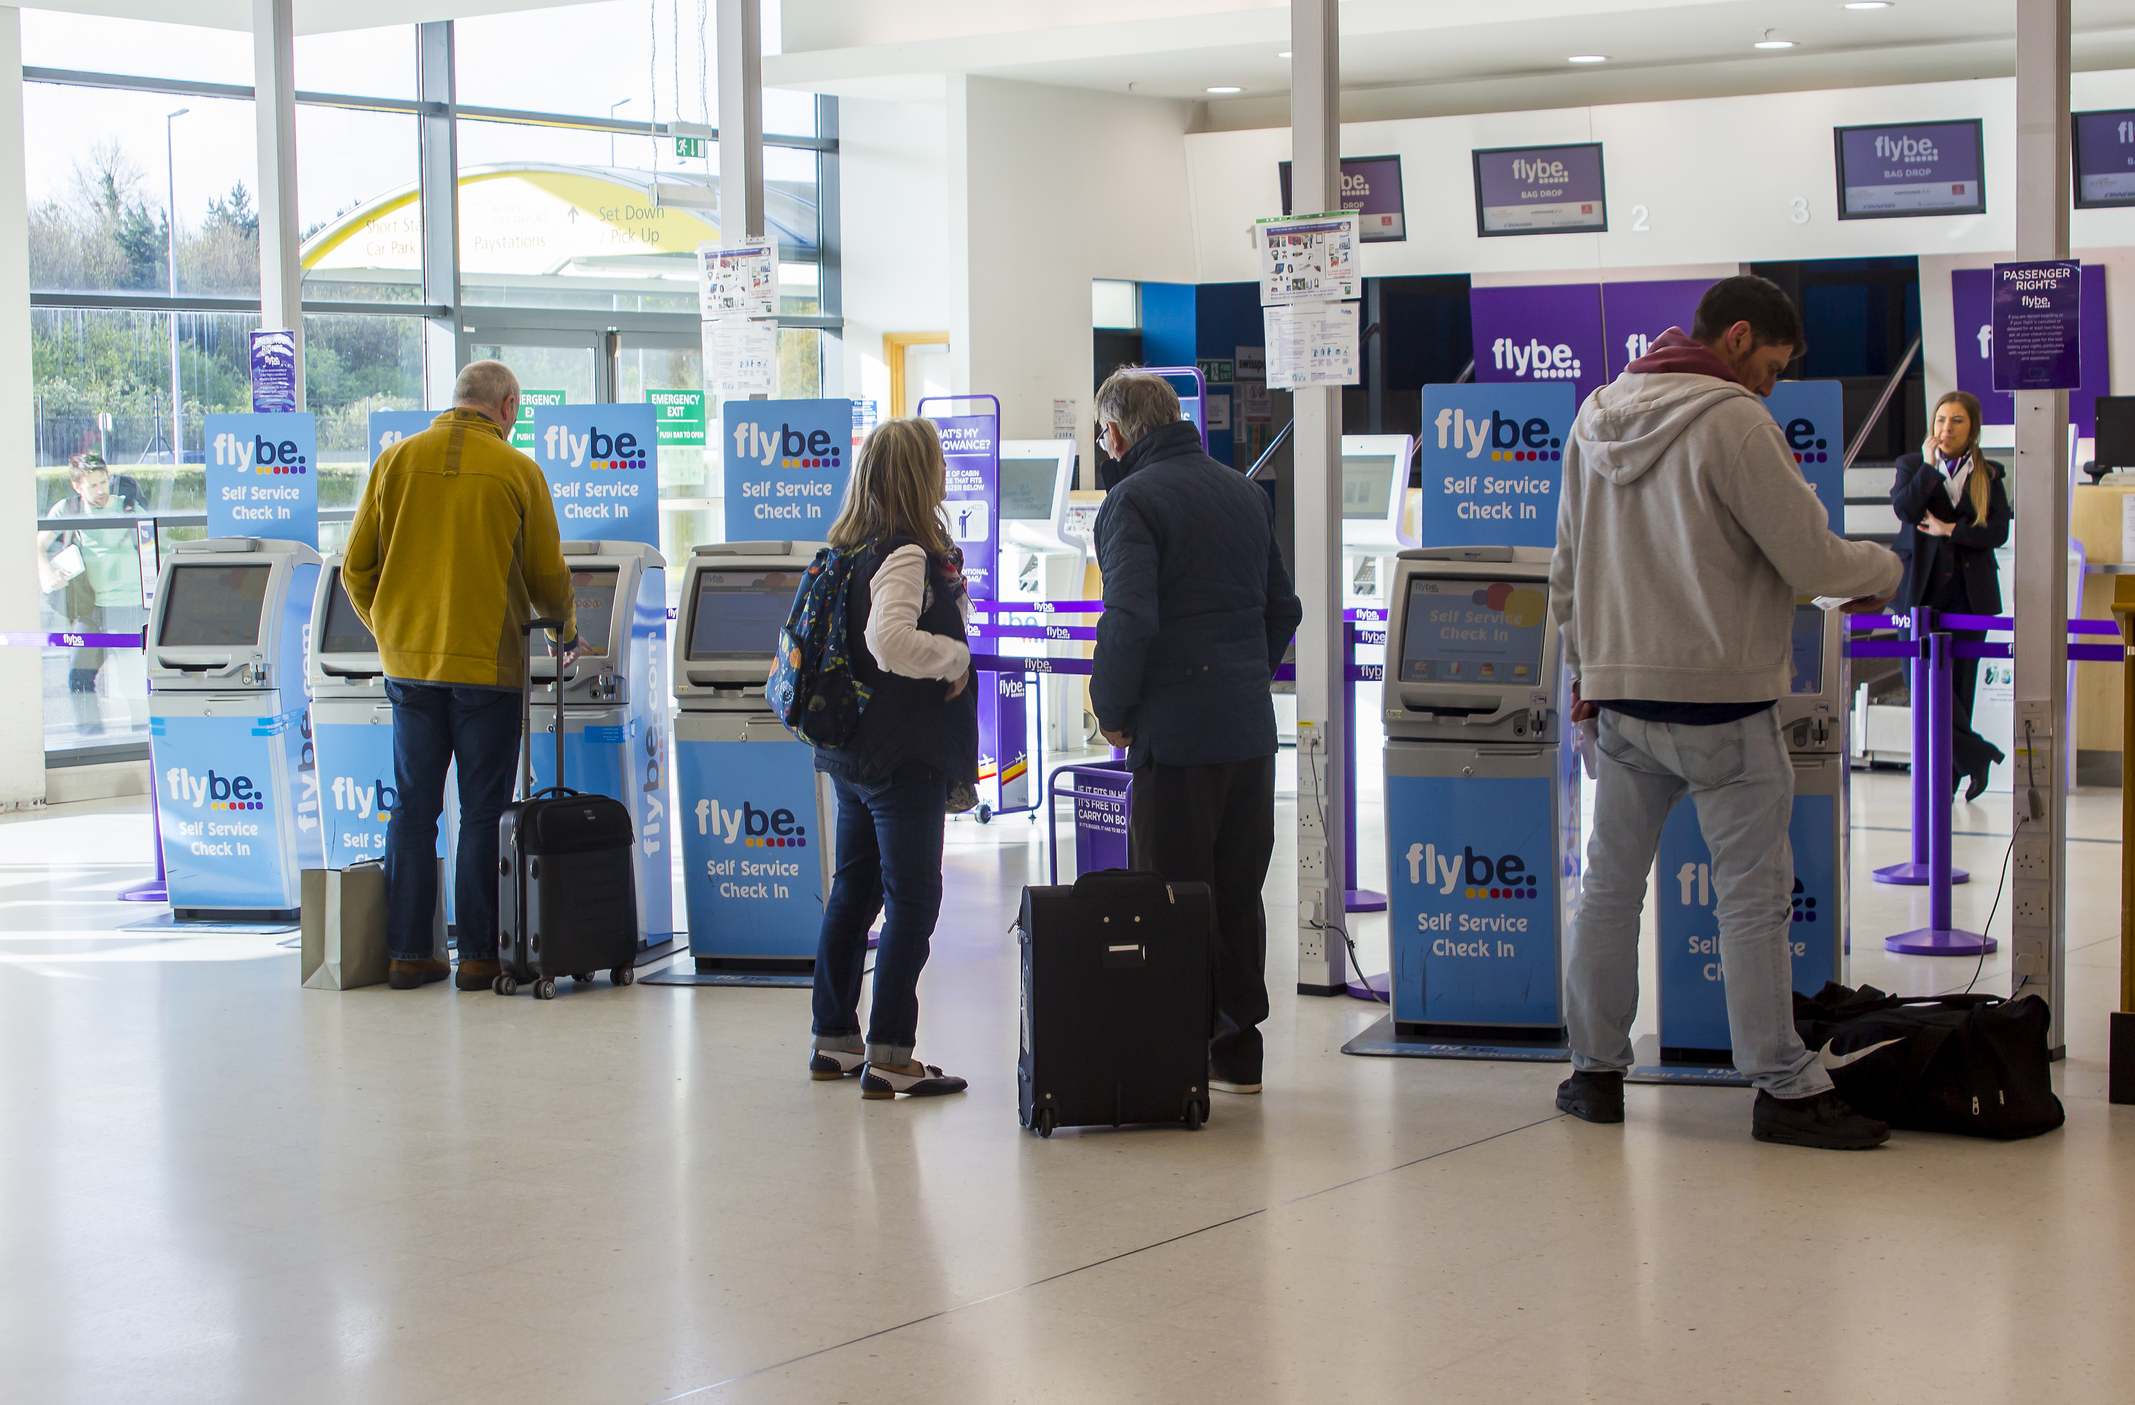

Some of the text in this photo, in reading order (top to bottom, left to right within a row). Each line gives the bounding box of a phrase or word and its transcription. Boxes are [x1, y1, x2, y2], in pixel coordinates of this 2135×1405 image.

[1875, 136, 1938, 162] flybe.
[1512, 158, 1569, 183] flybe.
[1884, 167, 1931, 178] BAG DROP
[1340, 171, 1370, 190] be.
[1521, 189, 1563, 199] BAG DROP
[599, 205, 665, 221] Set Down
[1343, 201, 1365, 209] DROP
[1790, 197, 1811, 224] 3
[366, 217, 422, 235] Short Sta
[1631, 205, 1650, 232] 2
[474, 233, 546, 254] Paystations
[611, 227, 660, 246] Pick Up
[366, 239, 416, 256] Car Park
[2003, 268, 2071, 280] PASSENGER
[2016, 279, 2057, 291] RIGHTS
[2022, 295, 2050, 308] flybe.
[1492, 337, 1581, 377] flybe.
[519, 394, 561, 406] ERGENCY
[651, 394, 700, 405] EMERGENCY
[667, 406, 685, 417] EXIT
[516, 433, 531, 441] PUSH
[659, 431, 672, 439] PUSH
[691, 431, 704, 439] OPEN
[938, 428, 979, 439] HAT'S MY
[1434, 408, 1561, 459] flybe.
[544, 425, 646, 468] flybe.
[733, 422, 840, 466] flybe.
[942, 440, 991, 451] OWANCE?
[213, 433, 306, 474] flybe.
[222, 486, 300, 501] Self Service
[553, 482, 639, 498] Self Service
[742, 481, 833, 498] Self Service
[1443, 476, 1550, 495] Self Service
[232, 505, 291, 521] Check In
[564, 503, 629, 519] Check In
[754, 503, 822, 519] Check In
[1456, 501, 1537, 521] Check In
[961, 568, 988, 576] DITIONAL
[1415, 582, 1438, 592] flybe.
[1033, 601, 1055, 612] flybe.
[1356, 609, 1379, 621] flybe.
[1430, 610, 1523, 625] Self Service
[1891, 615, 1911, 627] flyb
[63, 633, 84, 646] flybe.
[1046, 626, 1070, 639] flybe.
[1361, 631, 1385, 643] flybe
[1440, 627, 1508, 641] Check In
[1024, 658, 1052, 672] flybe.
[1361, 665, 1382, 679] flyb
[999, 679, 1025, 697] flybe.
[167, 767, 263, 808] flybe.
[331, 776, 398, 819] flyb
[1078, 798, 1120, 812] IT'S FREE TO
[694, 799, 806, 844] flybe.
[1078, 809, 1101, 822] CARRY
[1102, 813, 1114, 824] ON
[179, 821, 258, 837] Self Service
[191, 841, 251, 856] Check In
[343, 833, 369, 848] Self
[707, 860, 799, 876] Self Service
[1406, 843, 1537, 895] flybe.
[720, 883, 789, 899] Check In
[1418, 913, 1528, 933] Self Service
[1432, 938, 1515, 958] Check In
[1688, 936, 1721, 955] Sel
[1430, 1044, 1499, 1053] flybe.
